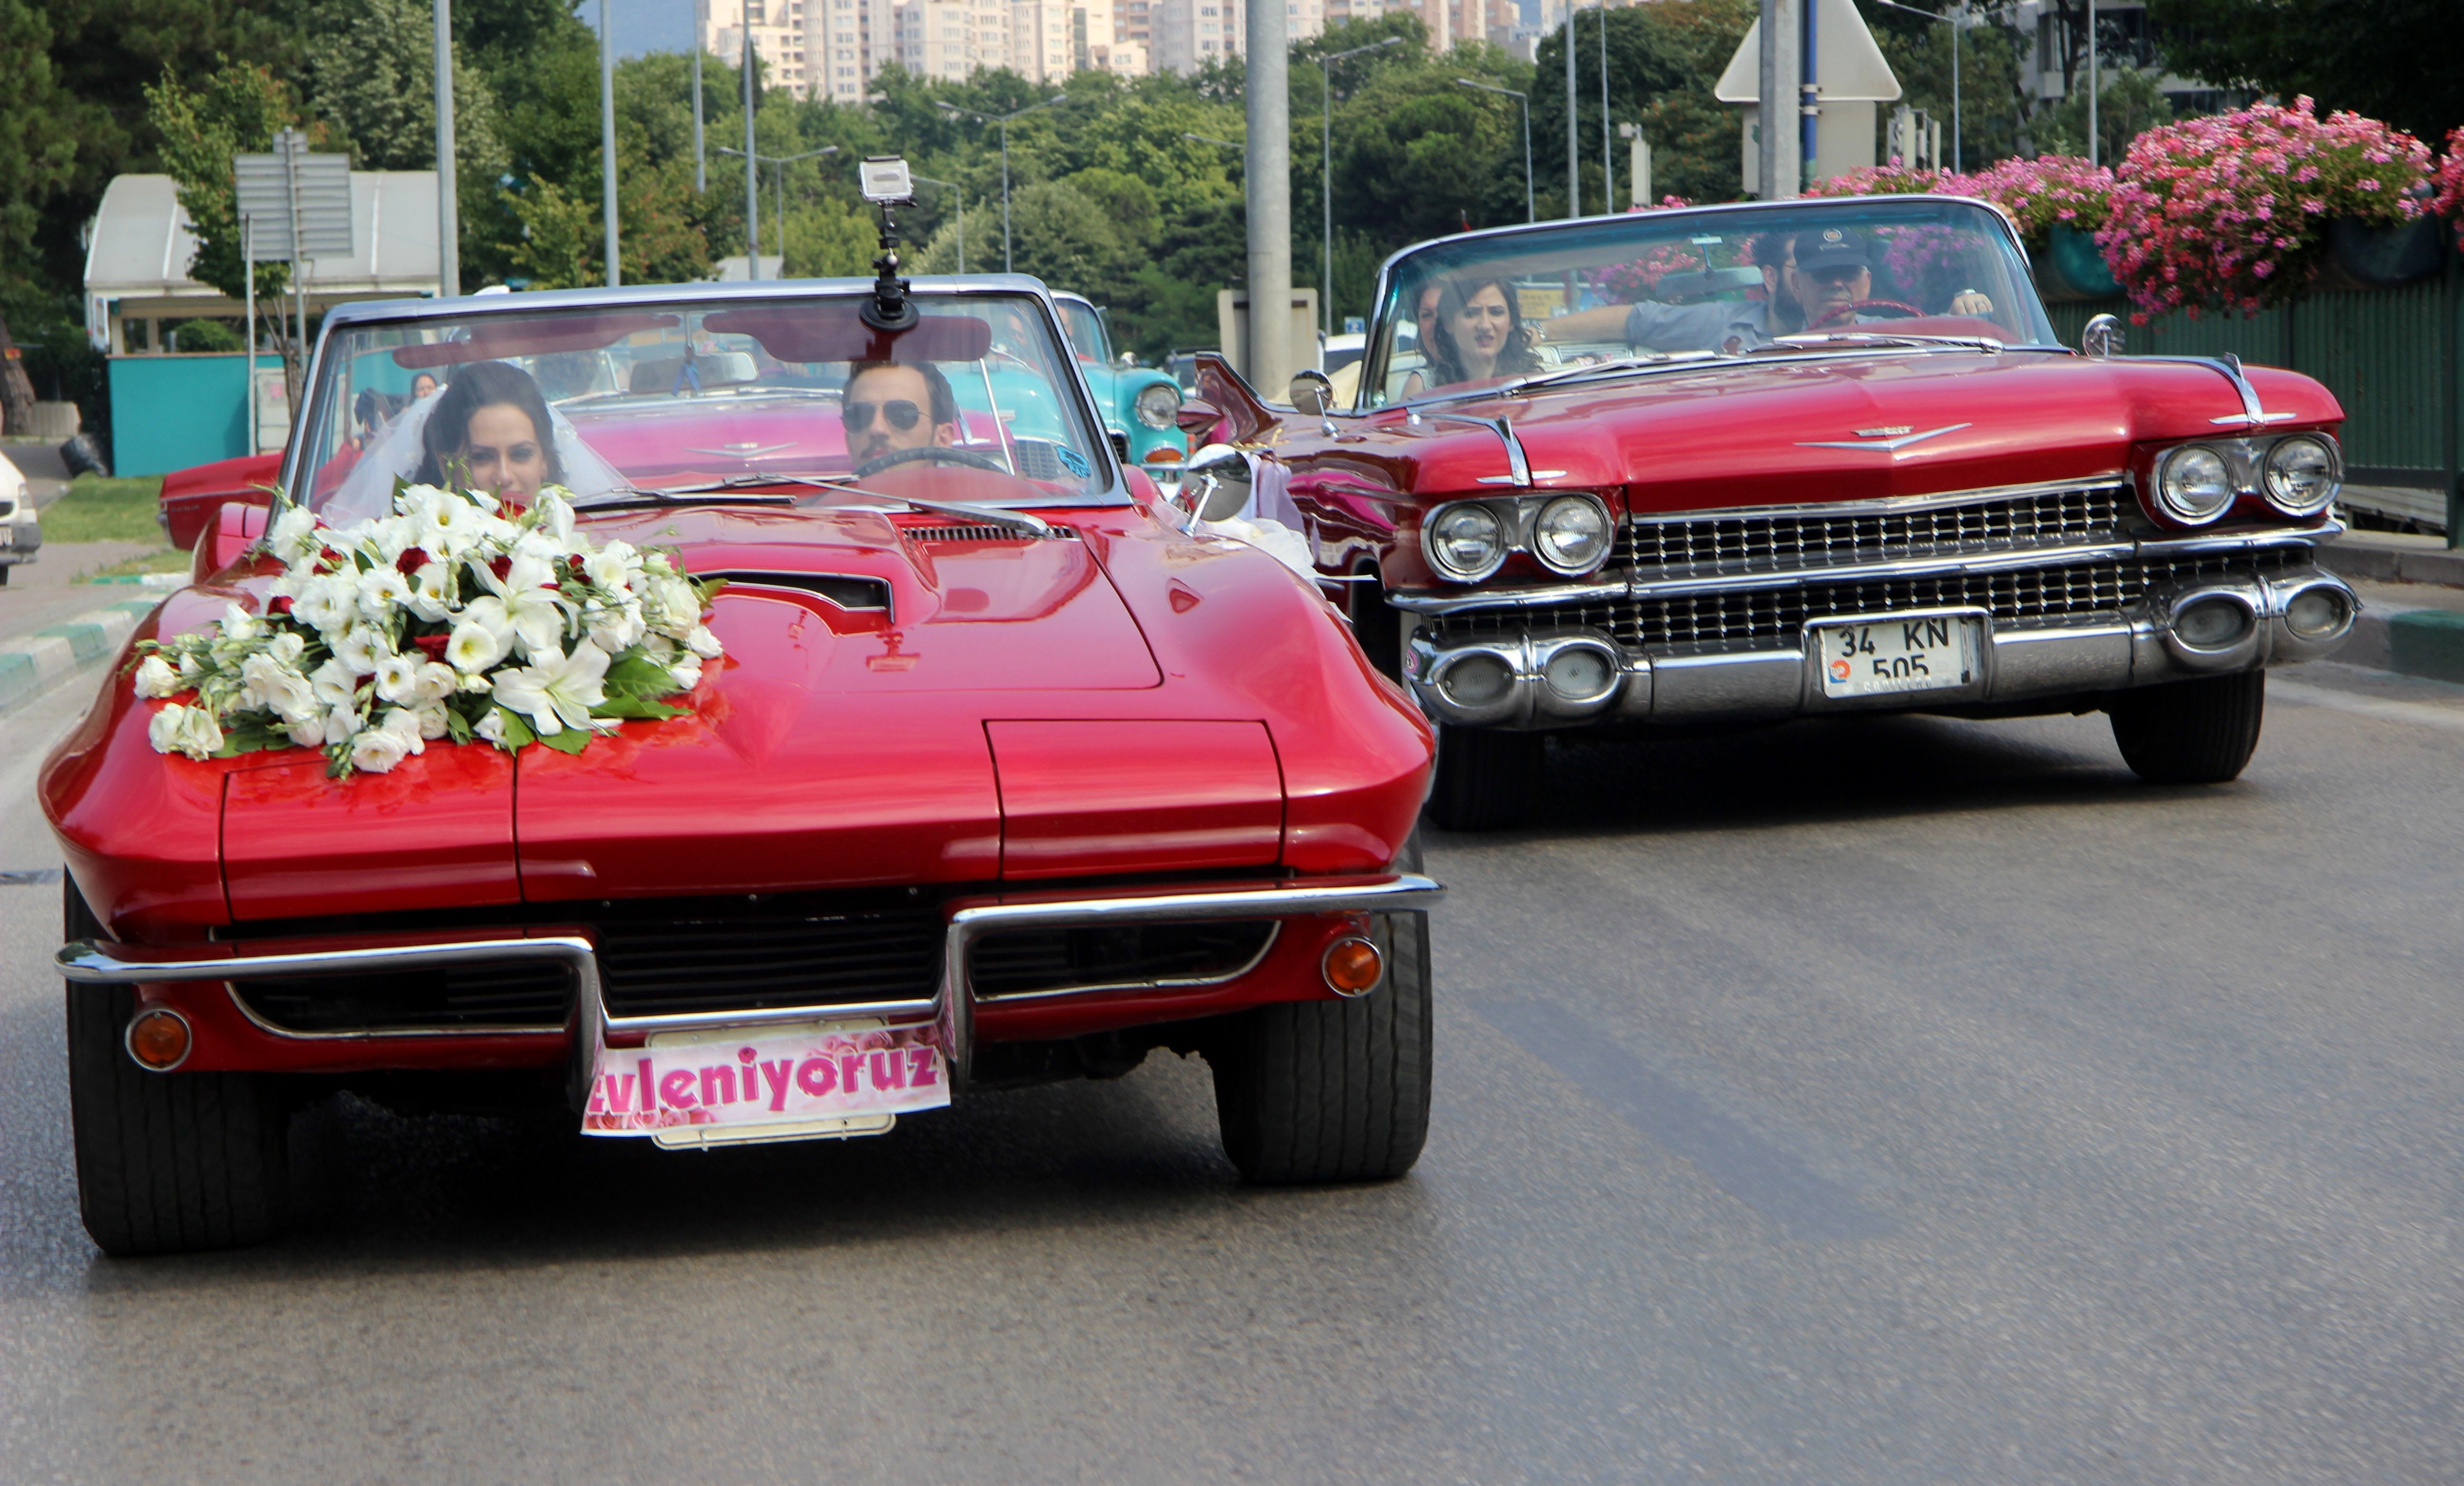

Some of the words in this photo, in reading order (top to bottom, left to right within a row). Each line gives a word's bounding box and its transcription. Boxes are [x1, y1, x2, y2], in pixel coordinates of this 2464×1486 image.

[1839, 627, 1875, 657] 34
[1903, 617, 1949, 651] KN
[1873, 653, 1929, 679] 505
